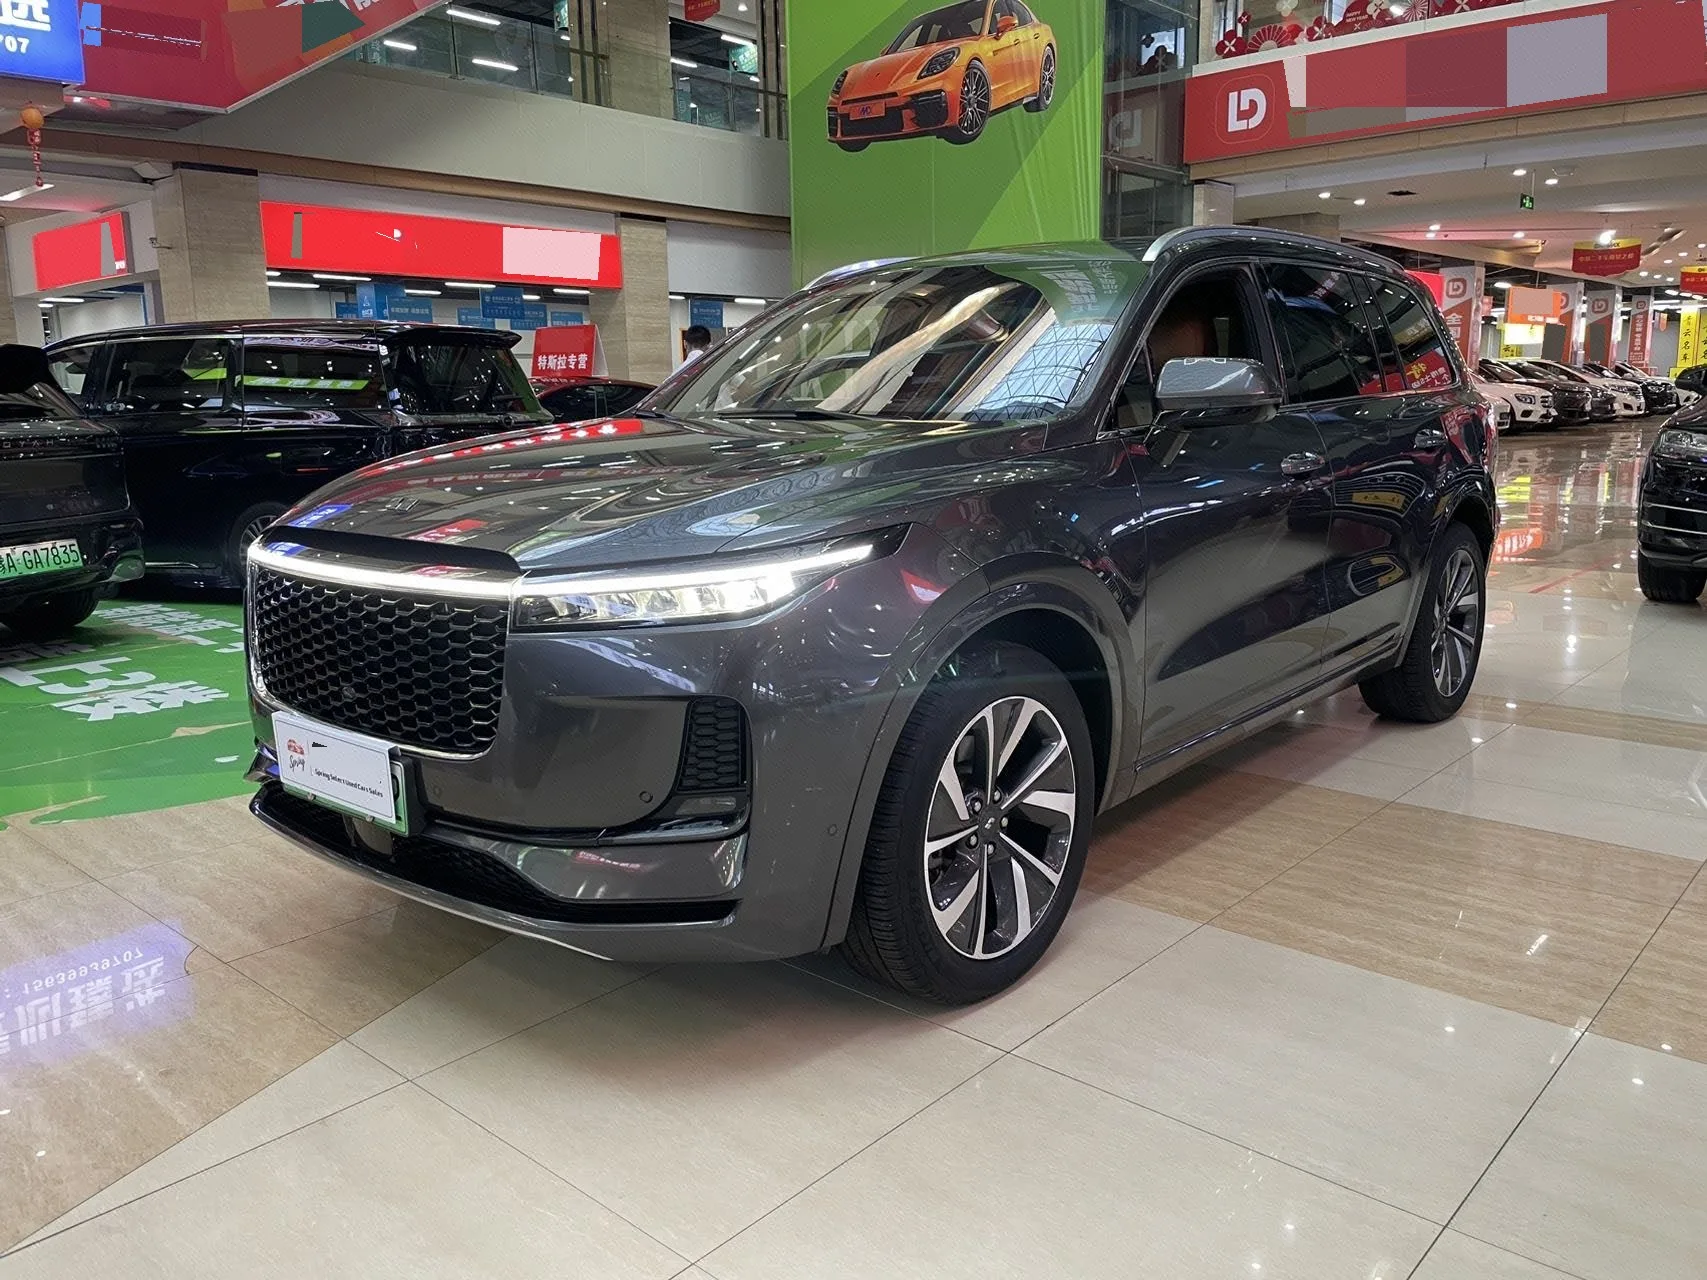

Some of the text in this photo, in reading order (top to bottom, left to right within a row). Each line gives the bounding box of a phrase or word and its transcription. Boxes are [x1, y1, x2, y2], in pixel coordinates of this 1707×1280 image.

[0, 35, 29, 54] 07
[537, 353, 588, 370] 特斯拉专营
